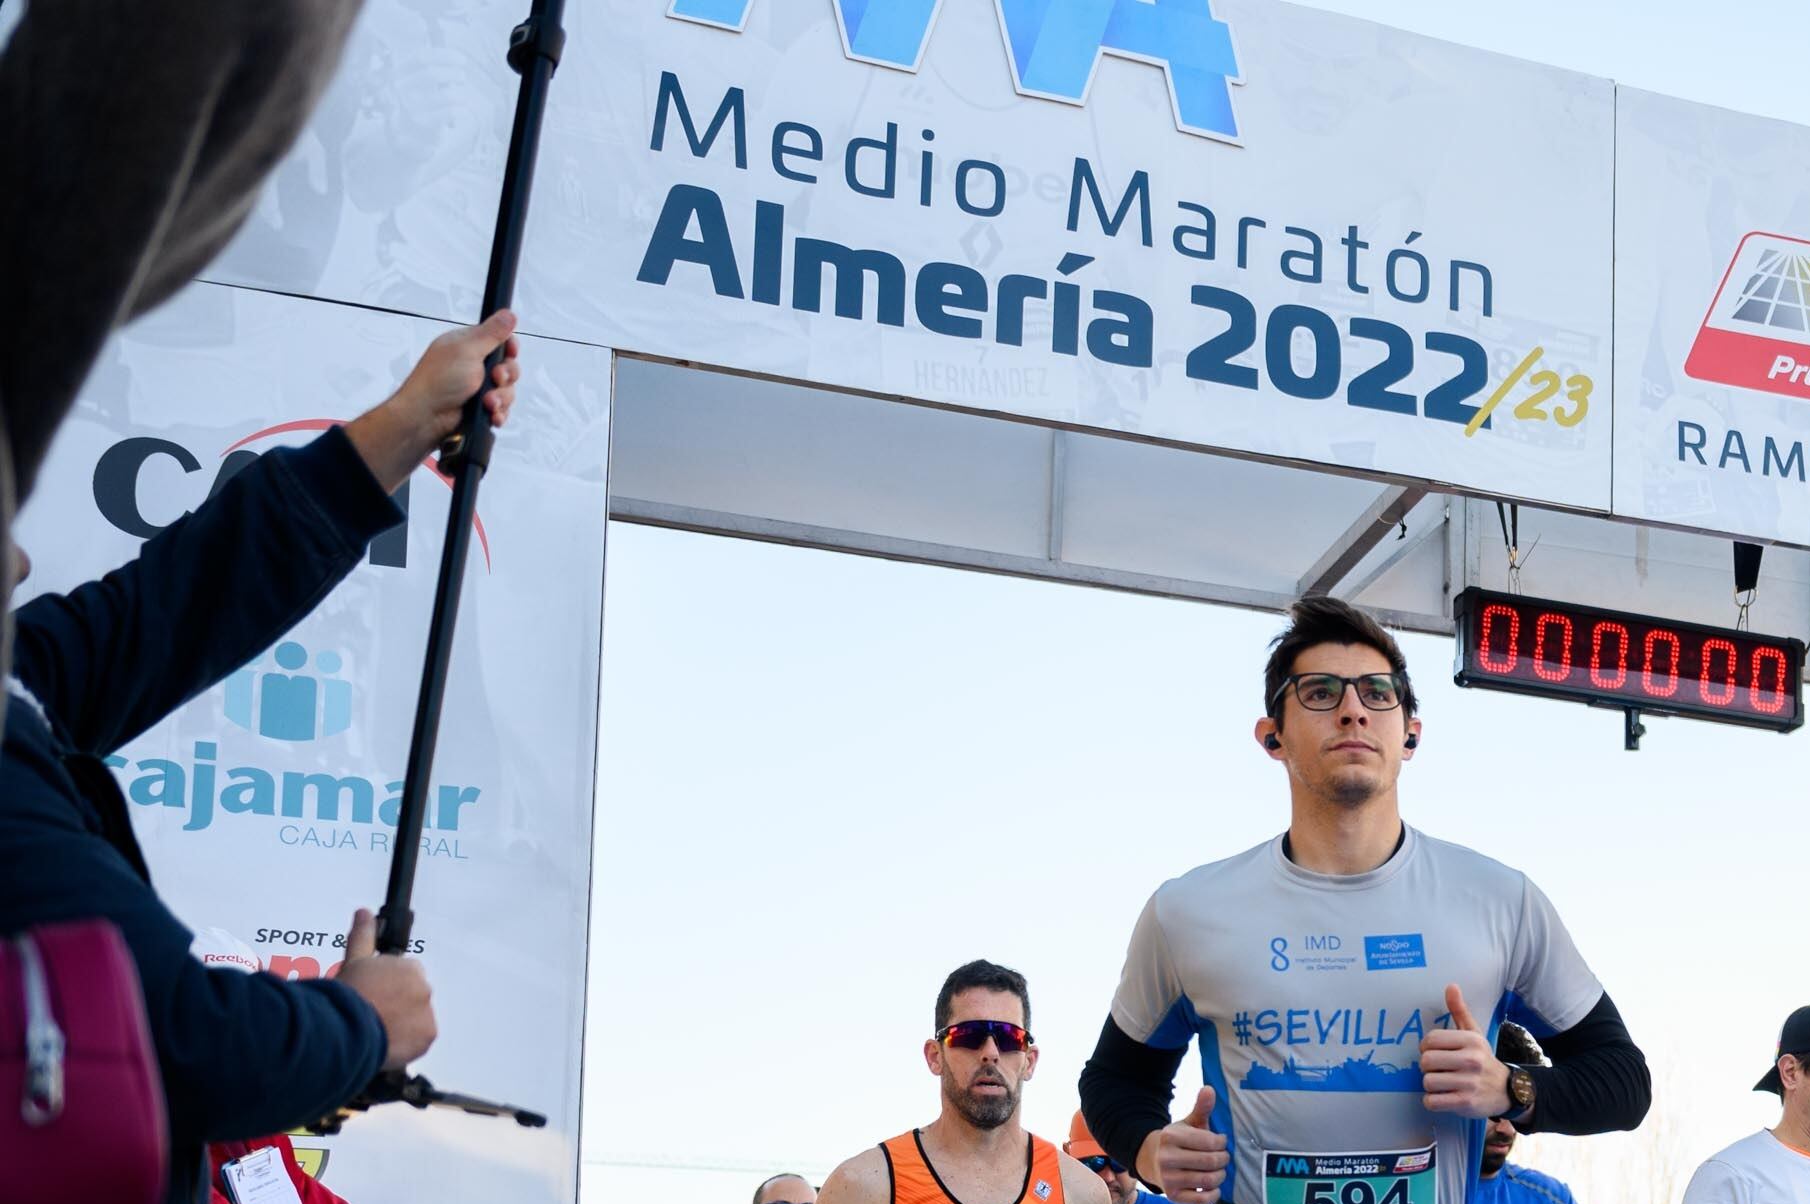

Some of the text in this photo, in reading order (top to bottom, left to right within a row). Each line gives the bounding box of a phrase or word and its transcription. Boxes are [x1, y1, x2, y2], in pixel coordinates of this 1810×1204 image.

[650, 71, 1006, 218] Medio
[1066, 157, 1493, 318] Maratón
[636, 183, 1154, 368] Almería
[279, 825, 469, 860] CAJA RRAL
[255, 928, 328, 948] SPORT
[332, 933, 349, 949] &
[1305, 936, 1341, 950] IMD
[1233, 1009, 1424, 1045] #SEVILLA
[1315, 1157, 1380, 1166] Medio Maratón
[1315, 1166, 1352, 1175] Almería
